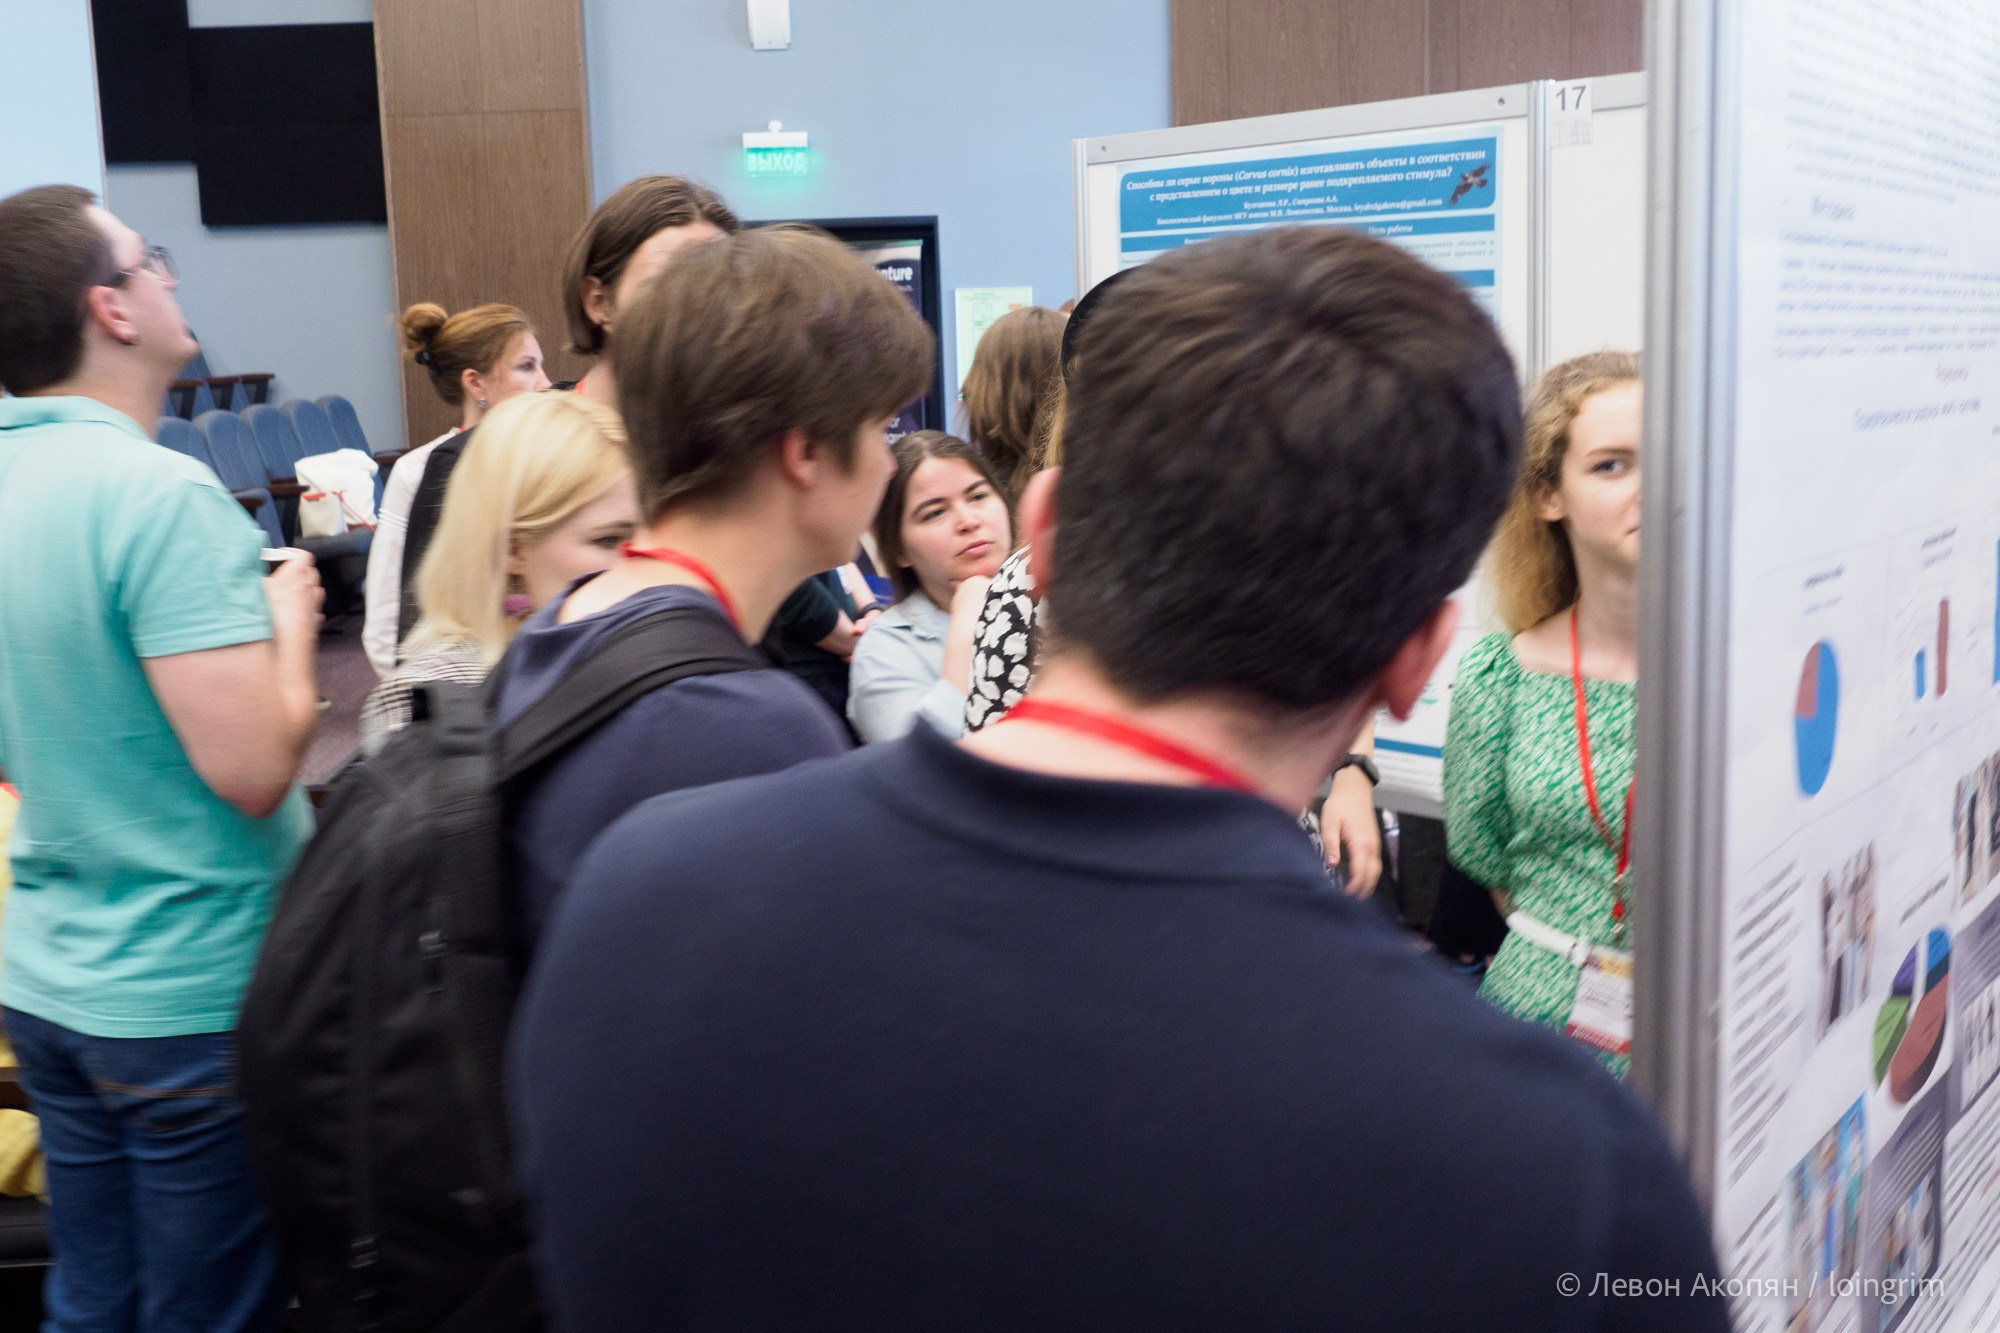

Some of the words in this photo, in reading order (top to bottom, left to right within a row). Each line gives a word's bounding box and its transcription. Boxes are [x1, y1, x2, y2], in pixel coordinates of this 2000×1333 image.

[1556, 86, 1586, 111] 17
[747, 152, 807, 174] ВЫХОД
[1126, 179, 1164, 191] Способны
[1165, 179, 1177, 187] ли
[1177, 177, 1201, 188] серые
[1203, 173, 1233, 186] вороны
[1235, 170, 1267, 182] (Corvus
[1268, 166, 1299, 179] cornix)
[1300, 160, 1365, 176] изготавливать
[1367, 157, 1408, 170] объекты
[1409, 157, 1416, 165] в
[1417, 150, 1486, 166] соответствии
[1156, 188, 1221, 203] представлением
[1229, 185, 1253, 196] цвете
[1254, 185, 1261, 193] и
[1262, 182, 1299, 195] размере
[1300, 180, 1325, 192] ранее
[1327, 172, 1404, 189] подкрепляемого
[1405, 166, 1453, 182] стимула?
[1387, 224, 1413, 235] работы
[877, 266, 913, 281] nture
